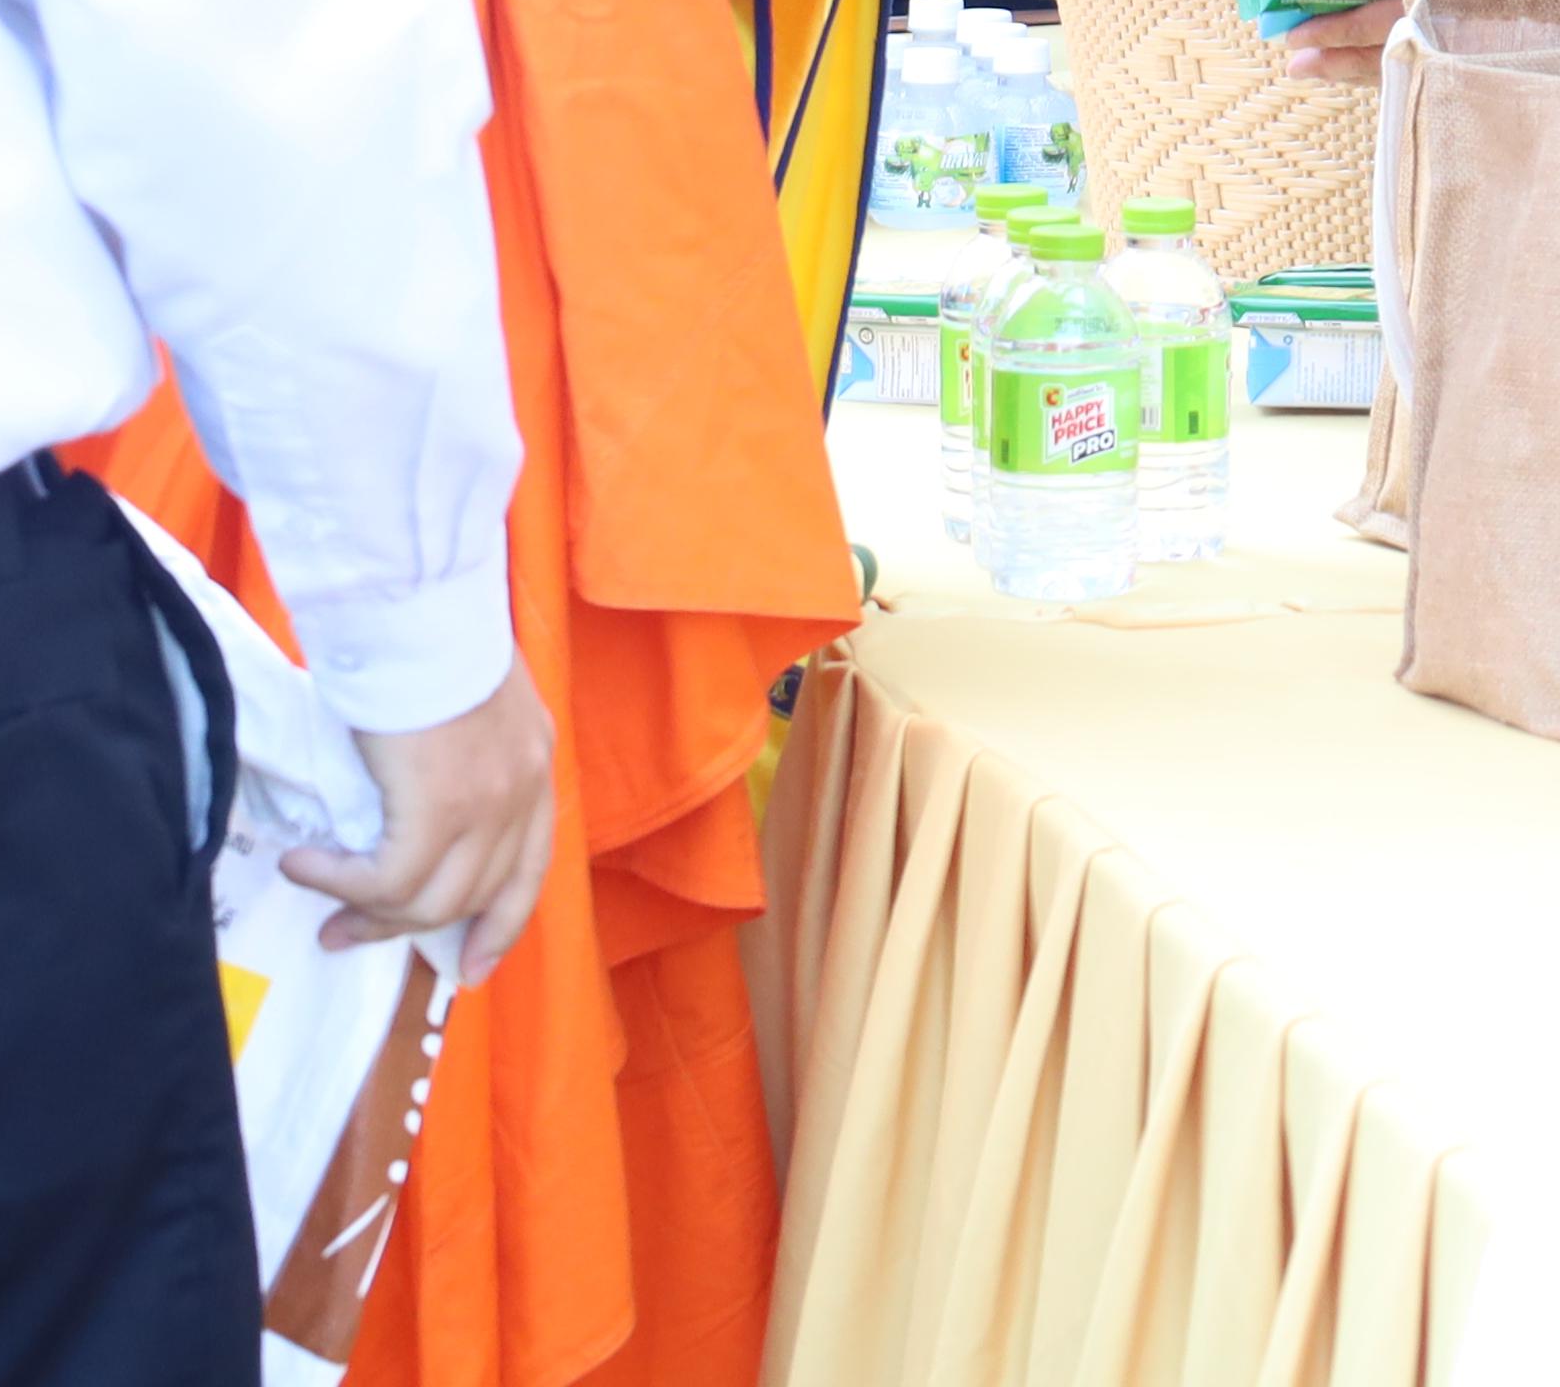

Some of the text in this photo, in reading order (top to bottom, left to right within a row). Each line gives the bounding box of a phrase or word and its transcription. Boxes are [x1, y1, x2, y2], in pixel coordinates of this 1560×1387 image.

[1051, 399, 1104, 430] HAPPY
[1054, 412, 1106, 445] PRICE
[1072, 431, 1115, 461] PRO
